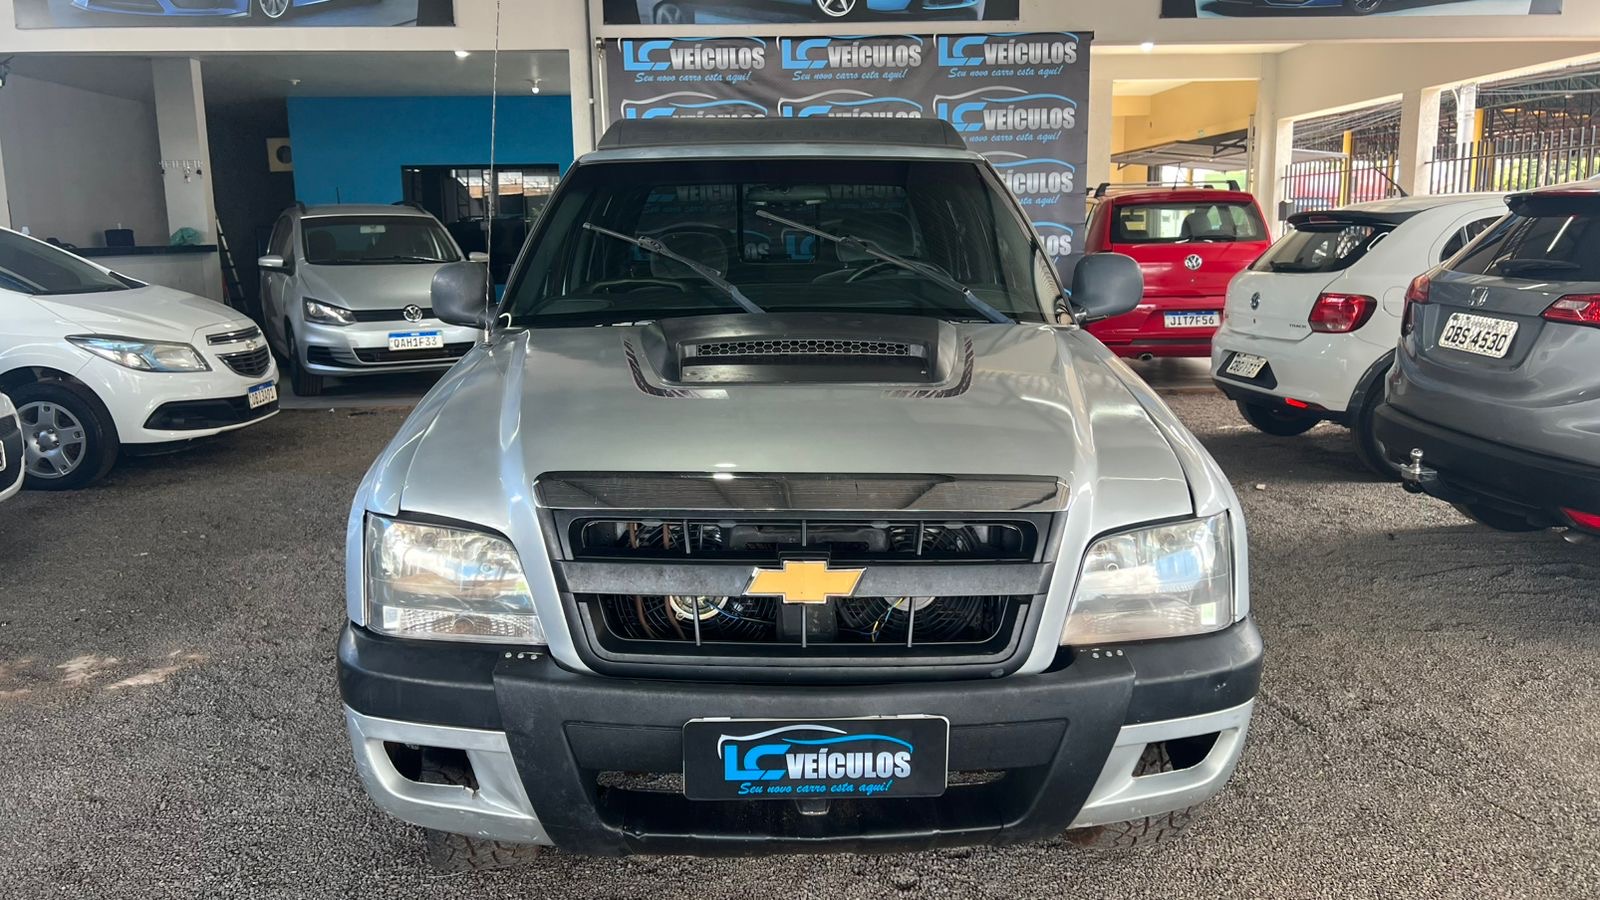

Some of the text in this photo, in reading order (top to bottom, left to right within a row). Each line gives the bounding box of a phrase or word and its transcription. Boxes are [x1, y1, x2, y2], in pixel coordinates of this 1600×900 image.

[669, 43, 766, 71] VEÍCULOS
[827, 42, 922, 68] VEÍCULOS
[984, 39, 1077, 65] VEÍCULOS
[635, 71, 752, 84] Seu novo carro esta aqui!
[792, 70, 811, 81] Seu
[861, 71, 880, 79] esta
[882, 68, 908, 82] aqui!
[948, 67, 967, 79] Seu
[991, 69, 1014, 77] carro
[1016, 67, 1035, 76] esta
[1038, 65, 1064, 79] aqui!
[983, 105, 1076, 131] VEÍCULOS
[969, 134, 988, 143] novo
[991, 134, 1014, 143] carro
[1015, 132, 1034, 142] esta
[1036, 130, 1063, 144] aqui!
[999, 169, 1074, 195] ÍCULOS
[1035, 194, 1060, 207] aqui!
[1170, 315, 1215, 326] JIT7F56
[785, 748, 912, 780] VEÍCULOS
[737, 779, 893, 796] Seu novo carro esta aqui!
